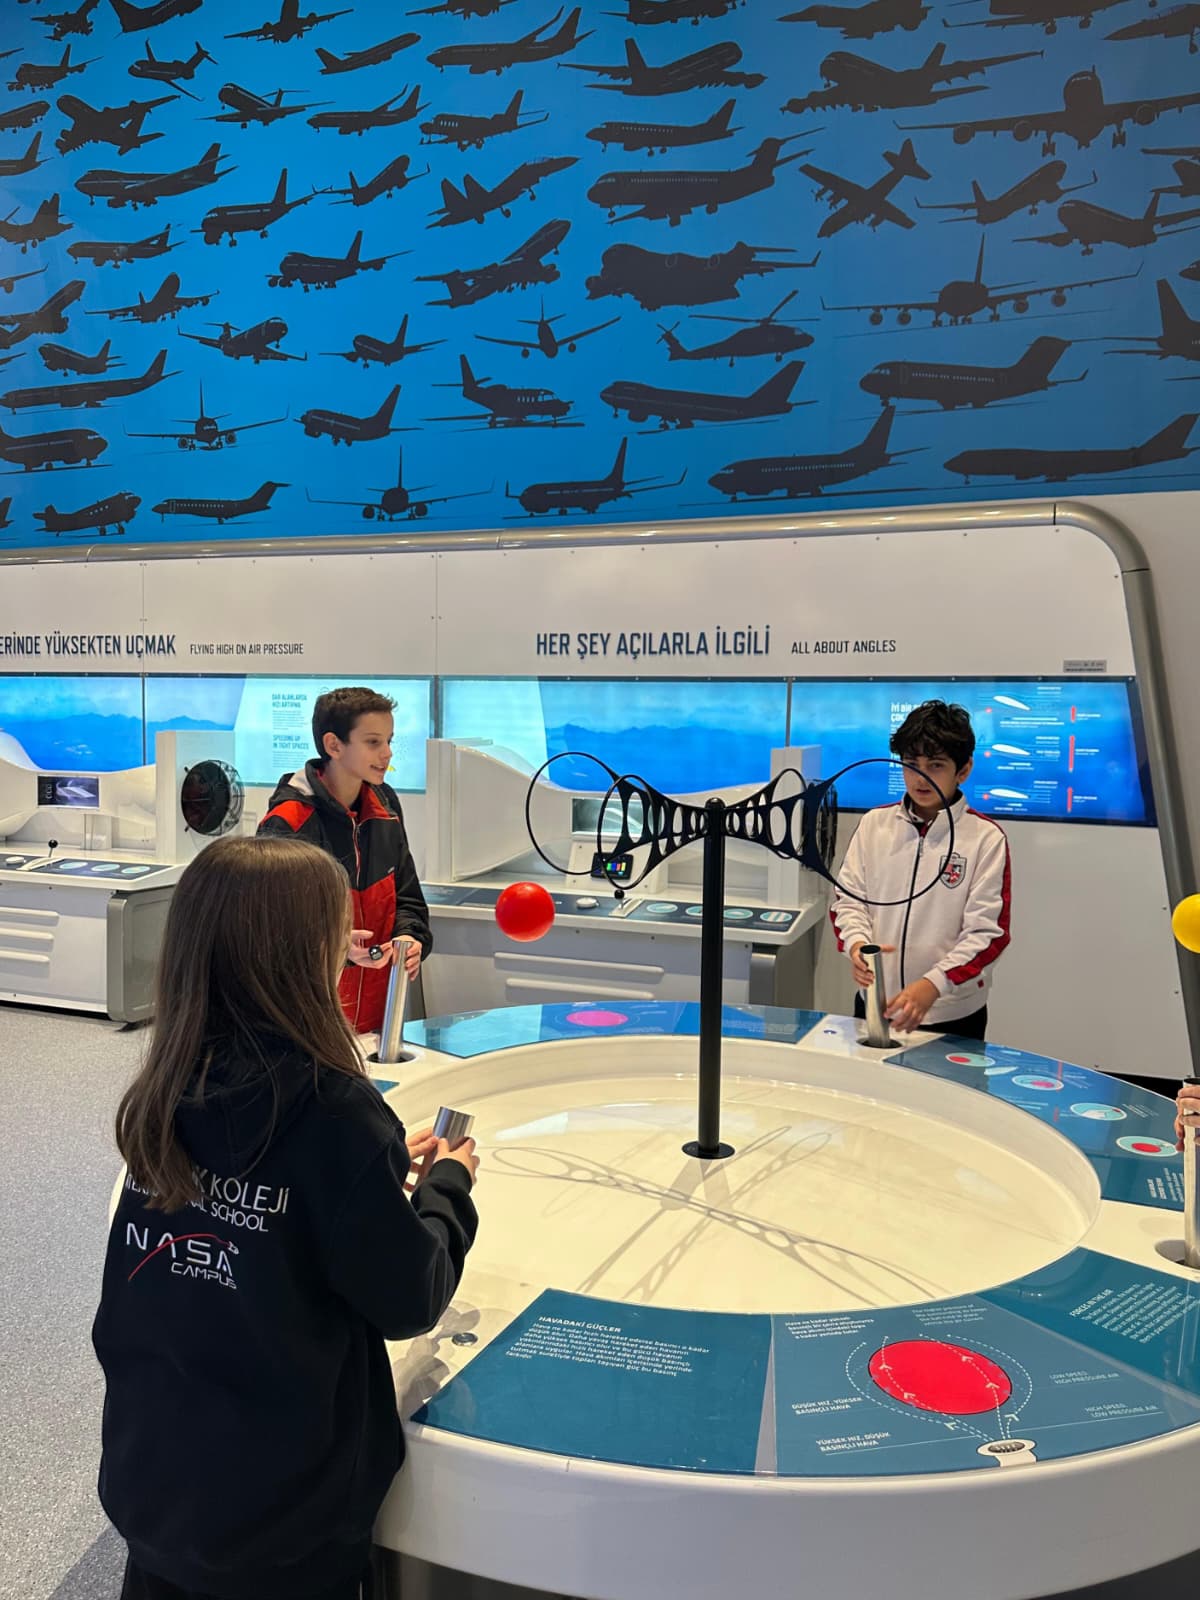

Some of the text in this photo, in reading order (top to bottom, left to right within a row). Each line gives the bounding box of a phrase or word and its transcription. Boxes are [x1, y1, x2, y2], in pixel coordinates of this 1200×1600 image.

[44, 631, 121, 655] YÜKSEKTEN
[125, 634, 177, 659] UÇMAK
[190, 643, 304, 655] FLYING HIGH ON AIR PRESSURE
[536, 624, 770, 659] HER ŞEY AÇILARLA İLGİLİ
[791, 639, 896, 654] ALL ABOUT ANGLES
[211, 1202, 269, 1233] SCHOOL
[127, 1222, 233, 1277] NASA
[171, 1262, 238, 1290] CAMPUS
[538, 1316, 622, 1334] HAVADAKİ GÜÇLER
[795, 1403, 852, 1415] BASINÇLI HAVA
[820, 1439, 880, 1452] BASINÇLI HAVA
